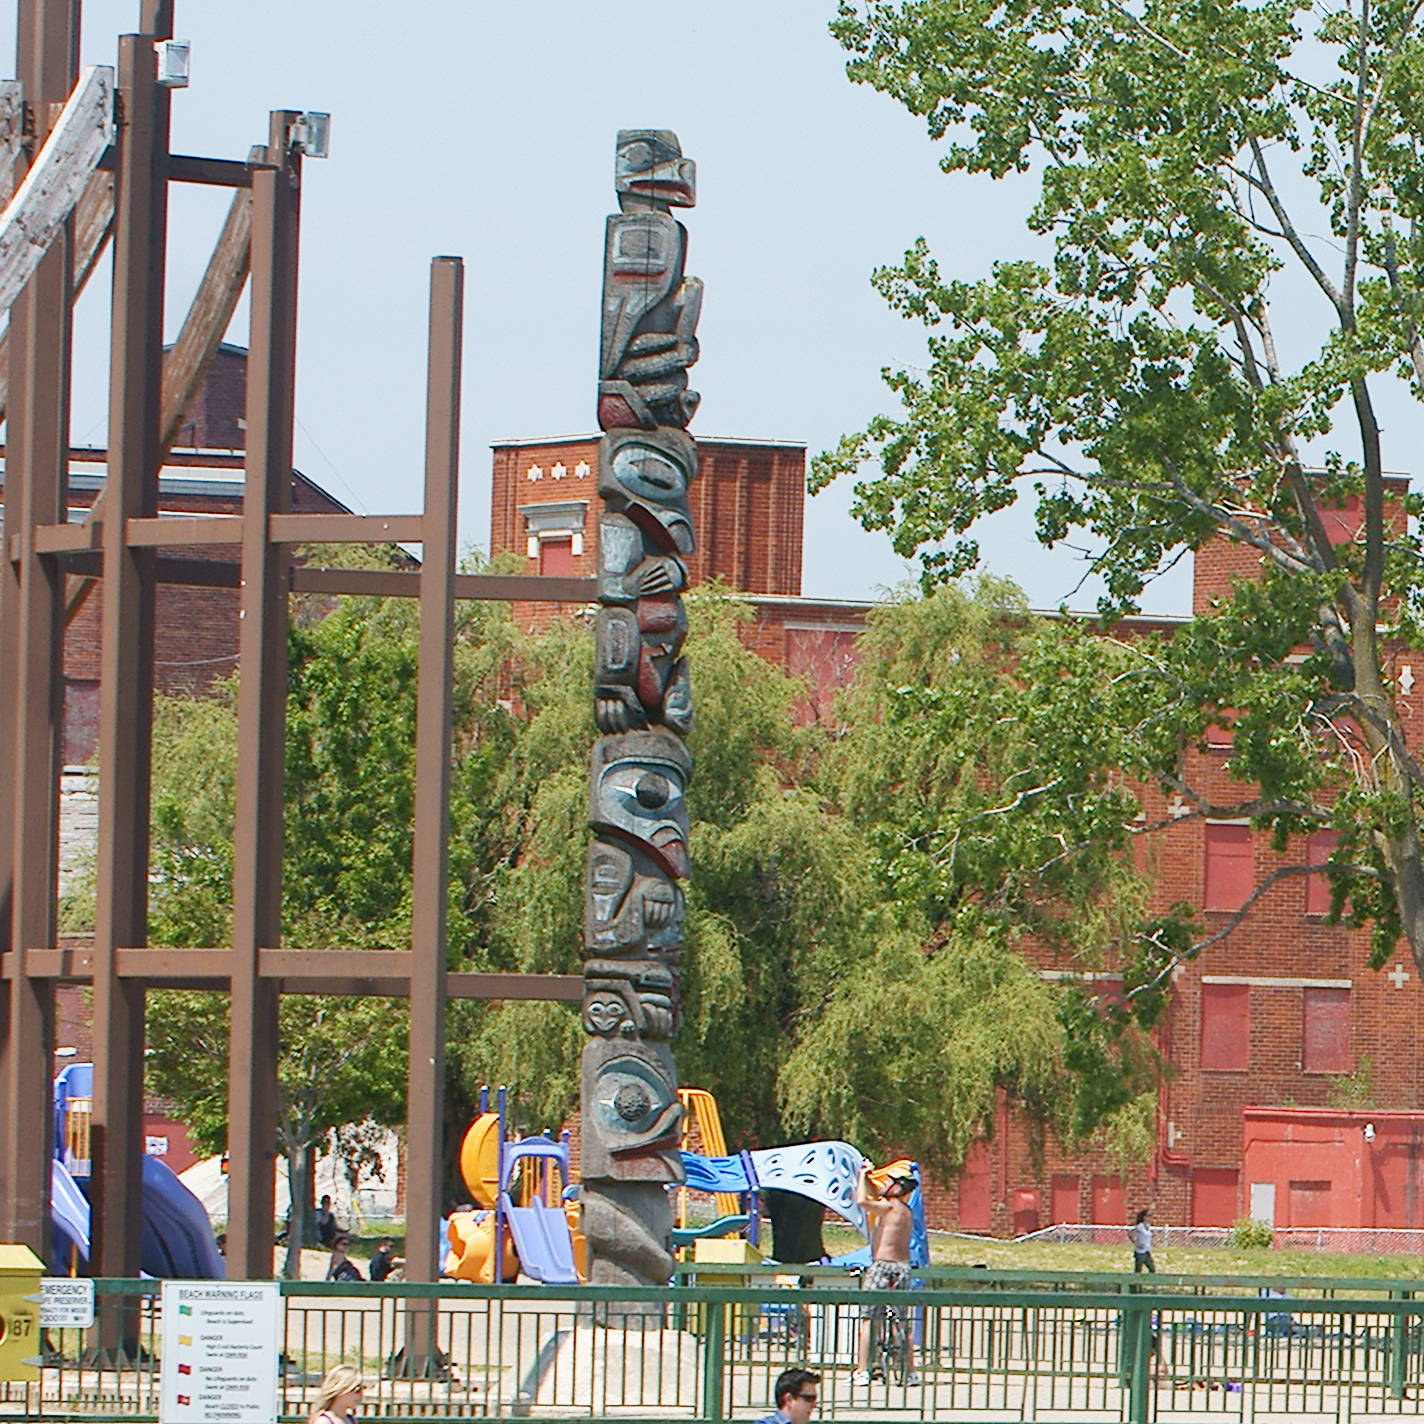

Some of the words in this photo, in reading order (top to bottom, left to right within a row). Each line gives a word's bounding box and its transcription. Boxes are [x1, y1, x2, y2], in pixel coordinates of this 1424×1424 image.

[179, 1289, 203, 1299] BEACH
[205, 1290, 239, 1300] WARNING
[240, 1291, 263, 1300] FLAGS
